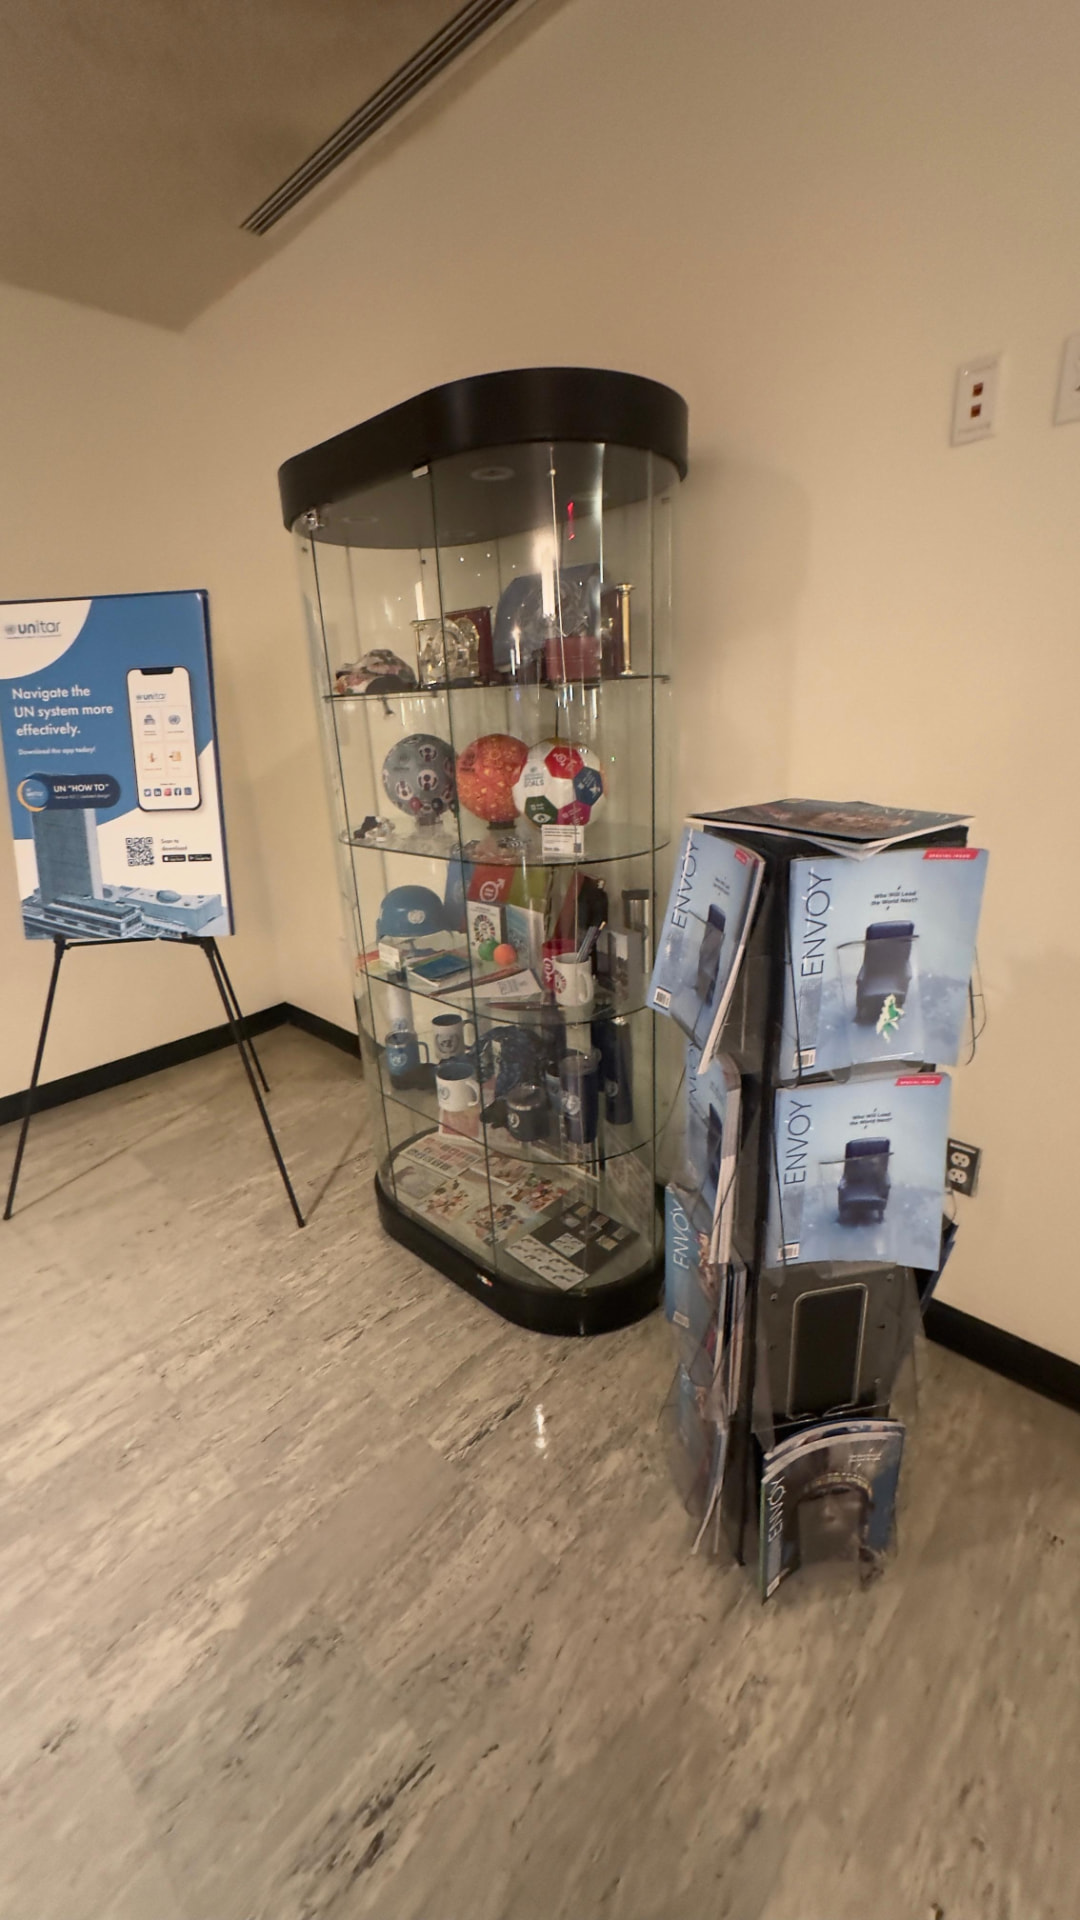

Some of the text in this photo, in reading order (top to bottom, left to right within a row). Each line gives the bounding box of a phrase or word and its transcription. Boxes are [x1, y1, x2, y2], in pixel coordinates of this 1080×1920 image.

[18, 620, 61, 634] unitar
[12, 684, 91, 702] Navigate the
[14, 705, 114, 720] UN system more
[16, 722, 81, 737] effectively.
[53, 785, 67, 793] UN
[671, 838, 699, 929] ENVOY
[801, 871, 832, 977] ENVOY
[784, 1100, 812, 1185] ENVOY
[767, 1475, 786, 1543] ENVOY
